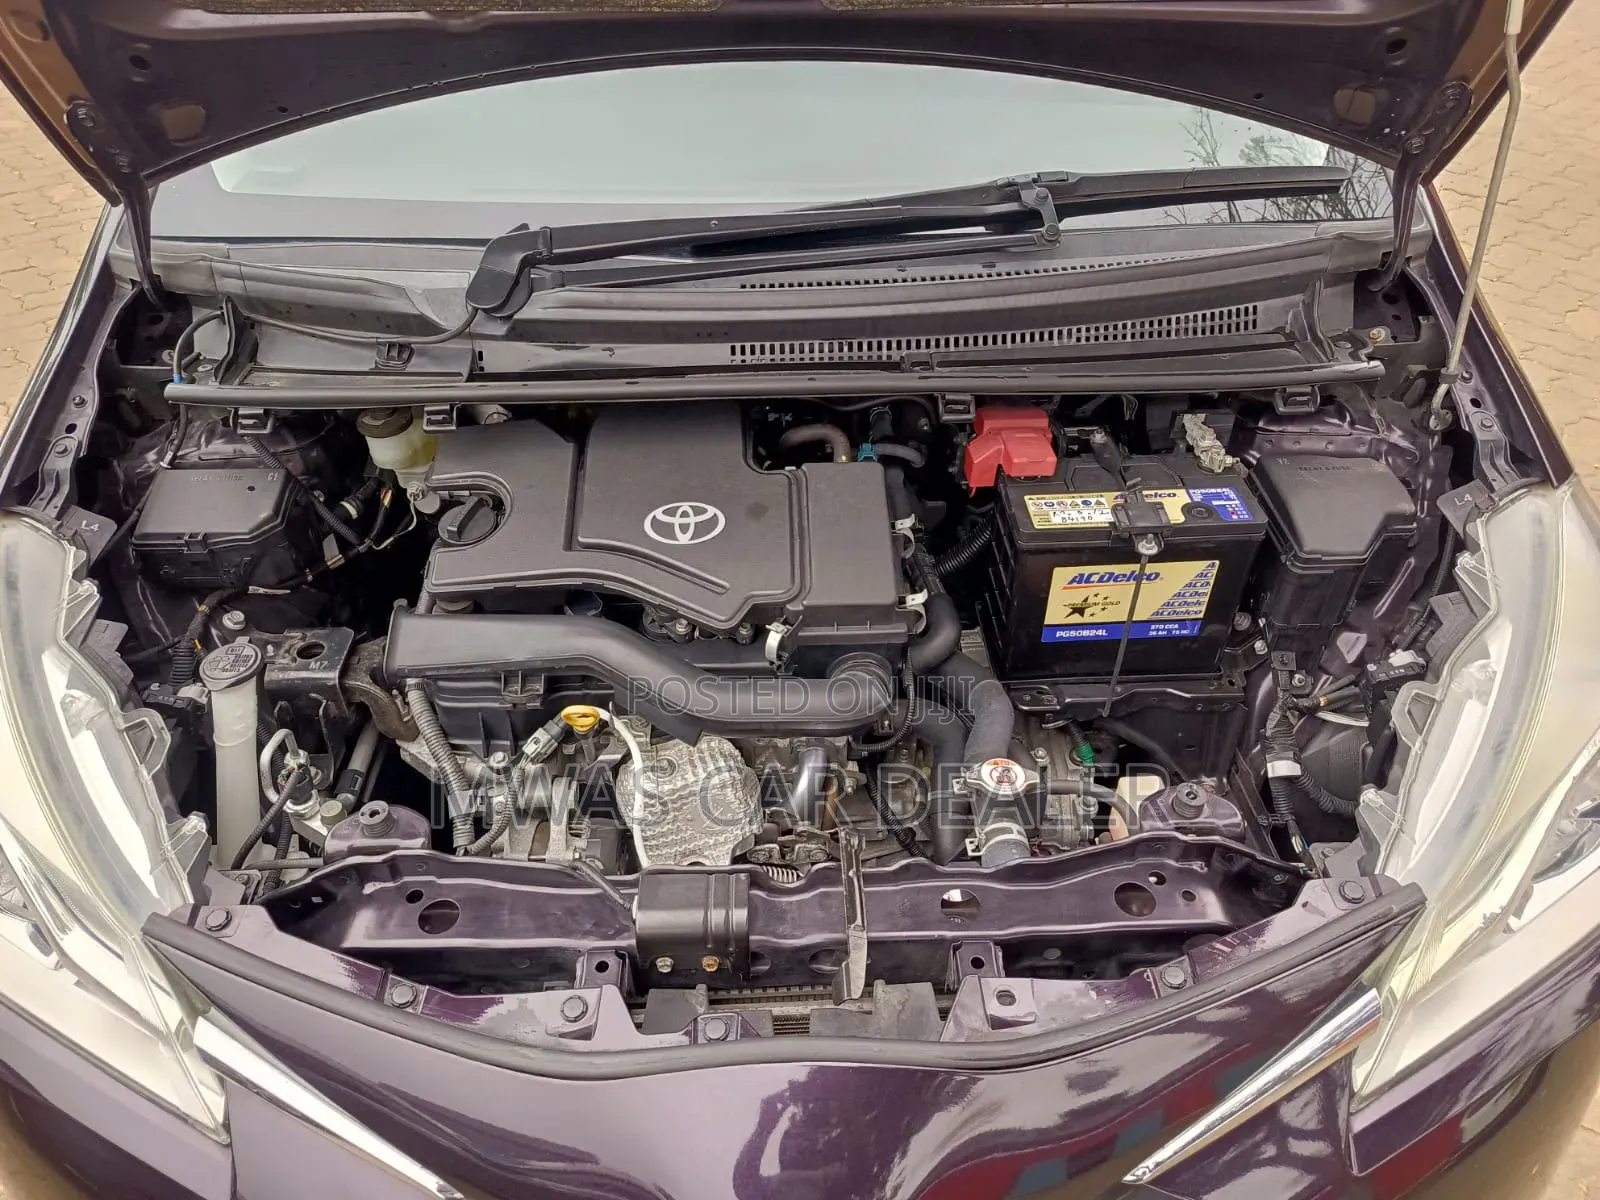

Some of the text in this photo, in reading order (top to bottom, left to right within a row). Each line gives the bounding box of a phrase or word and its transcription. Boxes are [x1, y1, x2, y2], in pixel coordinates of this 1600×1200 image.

[1066, 569, 1161, 586] ACDelco
[1150, 608, 1203, 617] ACDelco
[1055, 628, 1109, 638] PG50B24L
